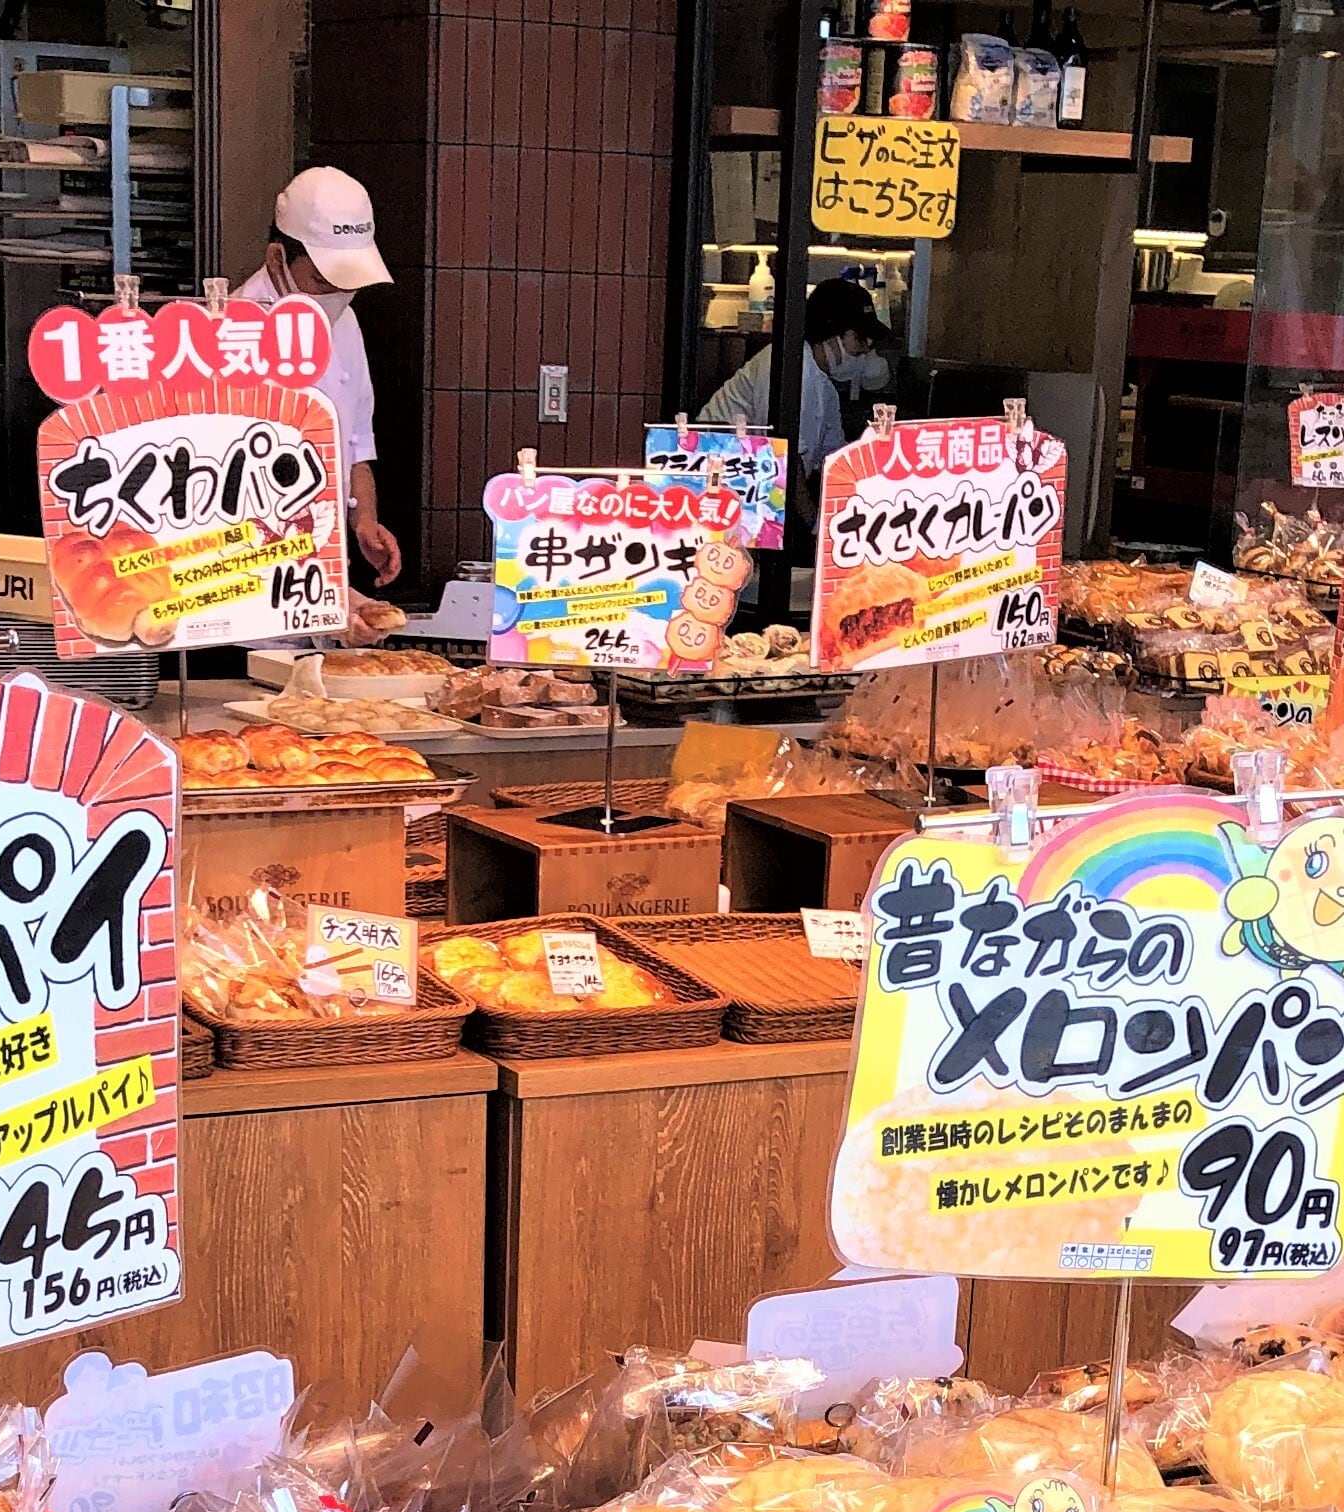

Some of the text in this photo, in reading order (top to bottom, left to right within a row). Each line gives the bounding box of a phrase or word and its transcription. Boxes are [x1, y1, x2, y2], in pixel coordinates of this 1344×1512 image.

[820, 121, 959, 169] ピザのご注文
[816, 171, 957, 228] はこちらです。
[650, 454, 779, 482] フライチキン
[883, 425, 1005, 473] 人気商品
[56, 430, 323, 529] ちくわパン
[500, 486, 740, 526] パン屋なのに大人気！
[838, 480, 1054, 558] さくさくカレーパン
[271, 564, 336, 609] 150円
[996, 591, 1050, 631] 150円
[584, 628, 640, 654] 255円
[322, 917, 399, 947] チーズ明太
[878, 864, 1185, 985] 昔ながらの
[879, 1098, 1194, 1160] 創業当時のレシピそのまんまの
[1182, 1123, 1334, 1231] 90円
[1218, 1226, 1339, 1269] 97円(税込)
[24, 1260, 168, 1321] 156円(税込)
